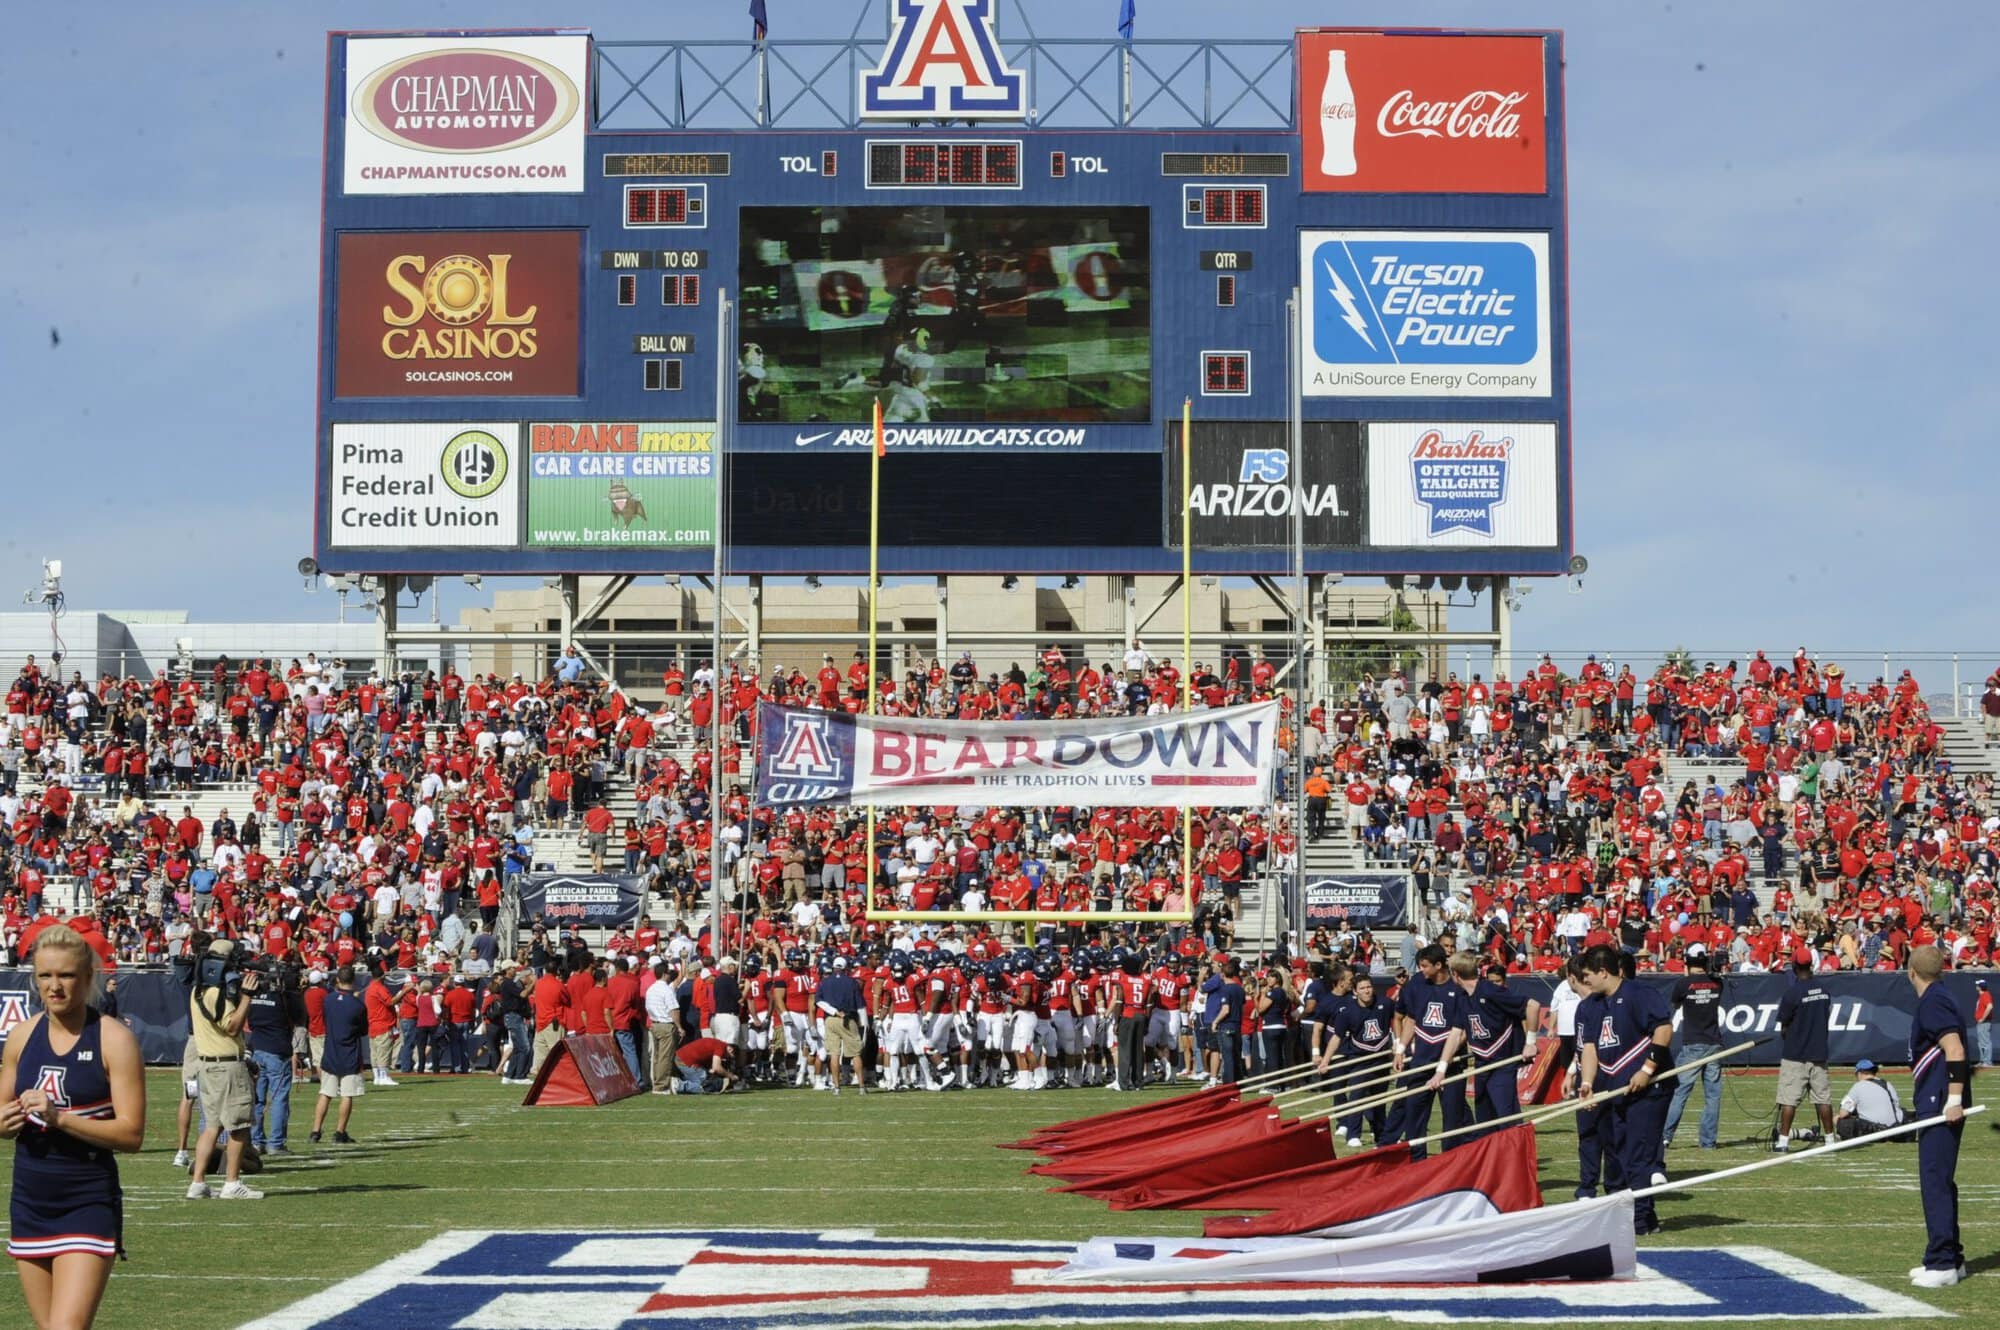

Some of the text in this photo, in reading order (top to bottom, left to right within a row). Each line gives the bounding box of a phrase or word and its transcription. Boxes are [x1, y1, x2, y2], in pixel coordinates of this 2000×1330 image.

[391, 75, 538, 113] CHAPMAN
[394, 115, 535, 128] AUTOMOTIVE
[1377, 89, 1529, 138] Coca-Cola
[361, 165, 567, 180] CHAPMANTUCSON.COM
[625, 155, 709, 176] ARIZONA
[780, 157, 817, 173] TOL
[904, 145, 1017, 183] 5:02
[1071, 157, 1108, 173] TOL
[1203, 155, 1244, 175] WSU
[614, 252, 639, 268] DWN
[664, 251, 698, 268] TO GO
[1215, 252, 1237, 268] QTR
[1370, 256, 1484, 286] Tucson
[383, 254, 537, 326] SOL
[1382, 287, 1515, 316] Electric
[1396, 317, 1514, 346] Power
[382, 328, 537, 360] CASINOS
[640, 336, 686, 352] BALL ON
[405, 371, 513, 382] SOLCASINOS.COM
[1207, 357, 1245, 389] 25
[1313, 372, 1537, 388] A UniSource Energy Company
[531, 425, 715, 453] BRAKE max
[1413, 432, 1511, 459] Bashas'
[342, 444, 404, 464] Pima
[534, 454, 711, 476] CAR CARE CENTERS
[1239, 448, 1290, 484] FS
[1420, 465, 1500, 476] OFFICIAL
[342, 475, 434, 495] Federal
[1420, 478, 1500, 489] TAILGATE
[1181, 484, 1340, 516] ARIZONA
[1421, 491, 1499, 500] HEADQUARTERS
[341, 507, 499, 527] Credit Union
[1434, 509, 1487, 518] ARIZONA
[534, 528, 710, 543] www.brakemax.com
[769, 712, 840, 780] A
[981, 774, 1146, 786] THE TRADITION LIVES
[1307, 888, 1380, 896] AMERICAN FAMILY
